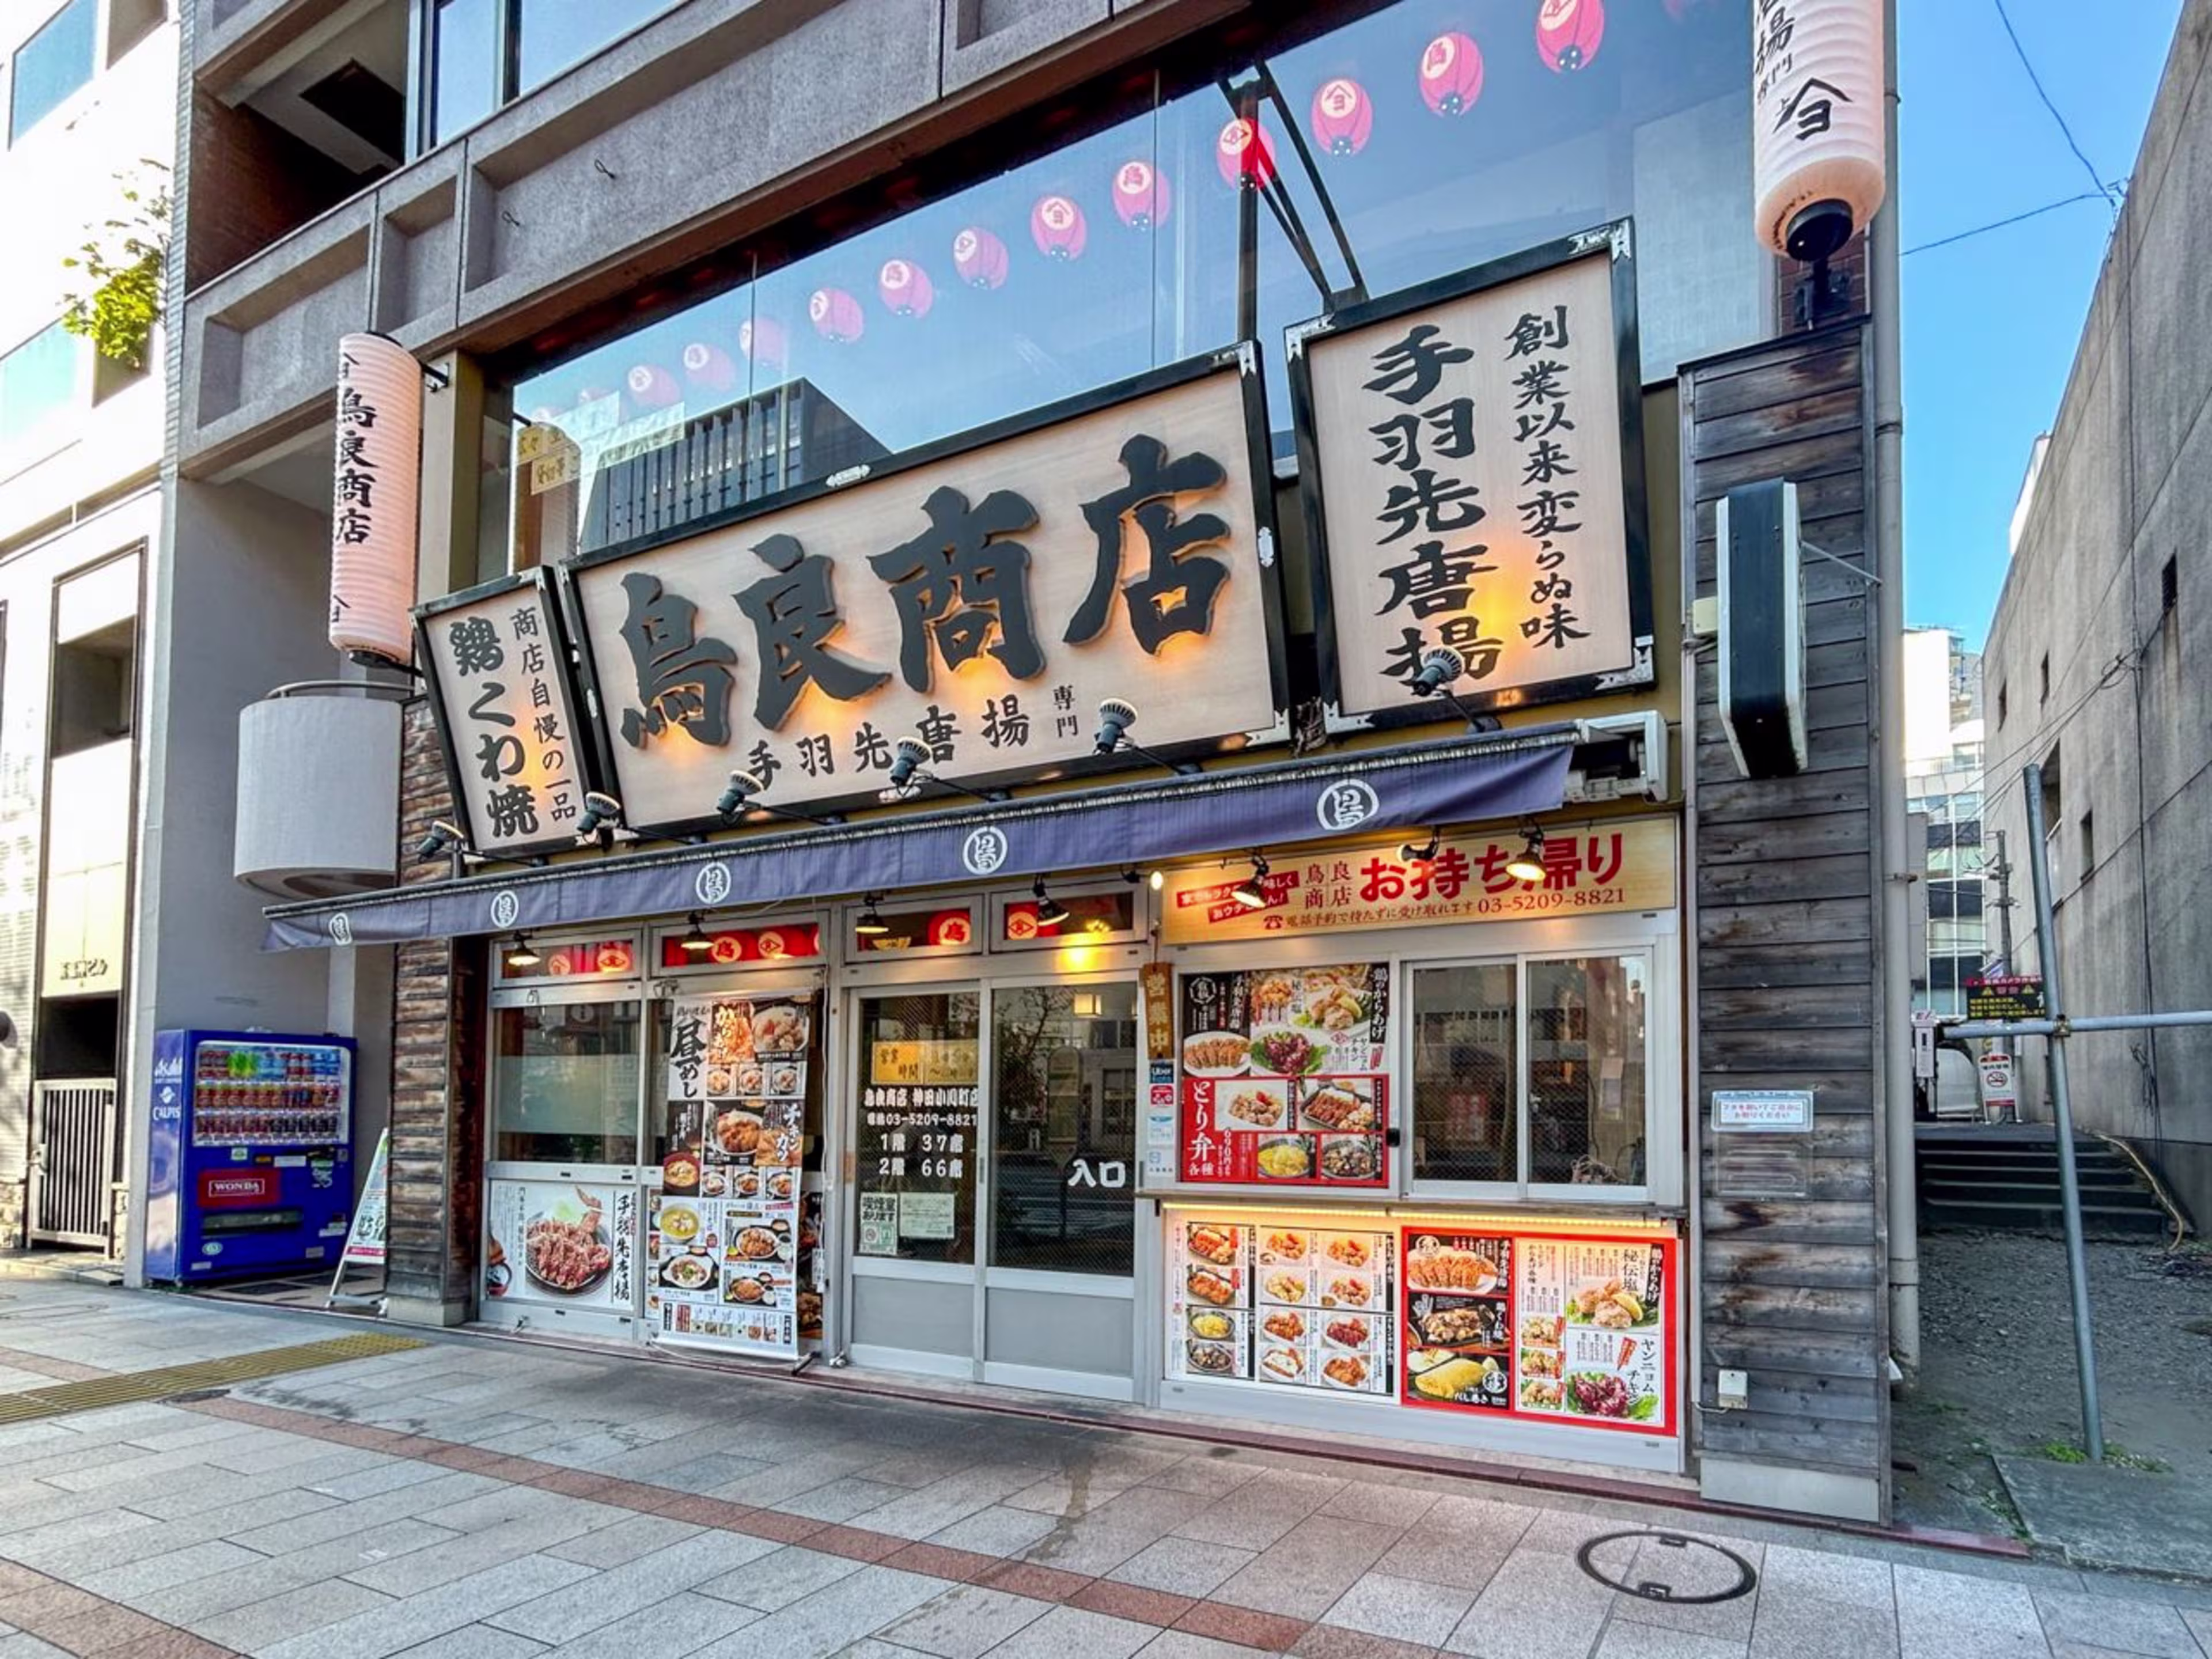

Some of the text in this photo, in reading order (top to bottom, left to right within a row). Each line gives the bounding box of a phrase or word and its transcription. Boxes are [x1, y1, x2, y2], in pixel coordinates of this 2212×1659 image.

[335, 387, 379, 546] 鳥良商店
[1362, 324, 1505, 688] 手羽先唐揚
[1505, 305, 1590, 649] 創業以来変らぬ味
[619, 433, 1233, 749] 鳥良商店
[509, 605, 577, 823] 商店自慢の一品
[748, 685, 1079, 789] 手羽先唐揚 専門
[1360, 833, 1623, 901] お持ち帰り
[1478, 888, 1626, 914] 03-5209-8821
[1147, 972, 1169, 1051] 営業中
[670, 1015, 707, 1098] 昼めし
[1187, 1081, 1217, 1162] とり弁
[1067, 1158, 1126, 1188] 入口
[1641, 1338, 1656, 1393] ヤンニョム
